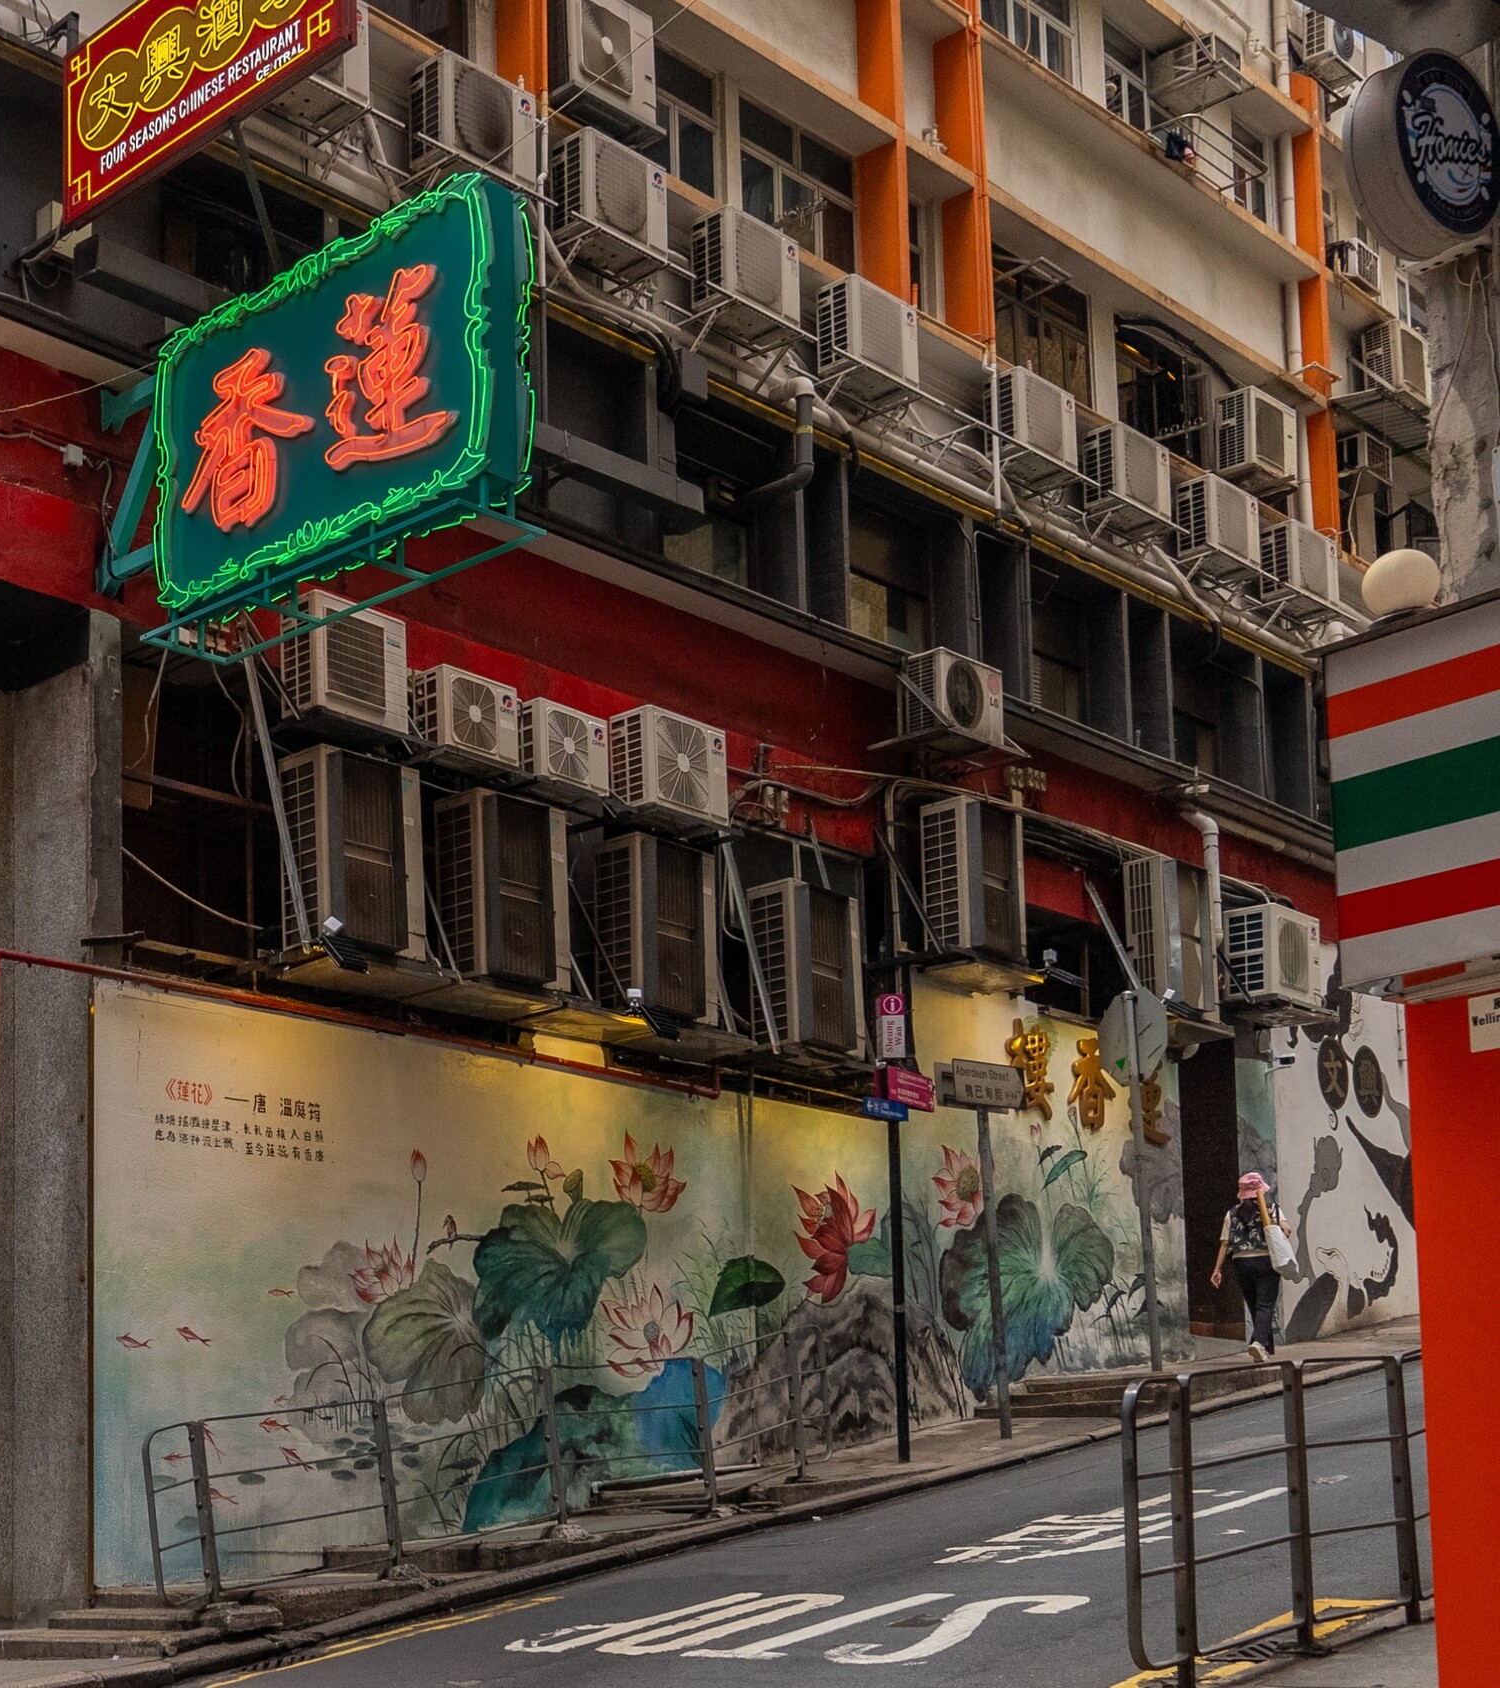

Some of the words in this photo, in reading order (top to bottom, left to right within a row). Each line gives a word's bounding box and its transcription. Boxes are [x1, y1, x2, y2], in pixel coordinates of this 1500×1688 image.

[86, 0, 293, 140] 文興酒
[255, 44, 305, 82] CENTRAL
[100, 142, 127, 175] FOUR
[129, 109, 178, 153] SEASONS
[227, 19, 302, 85] RESTAURANT
[1413, 112, 1486, 168] Homies
[885, 1020, 895, 1053] Sheung
[894, 1026, 902, 1046] Wan
[956, 1065, 988, 1079] Aberdeen
[988, 1069, 1010, 1082] Street
[965, 1083, 1002, 1101] 鴨巴甸街
